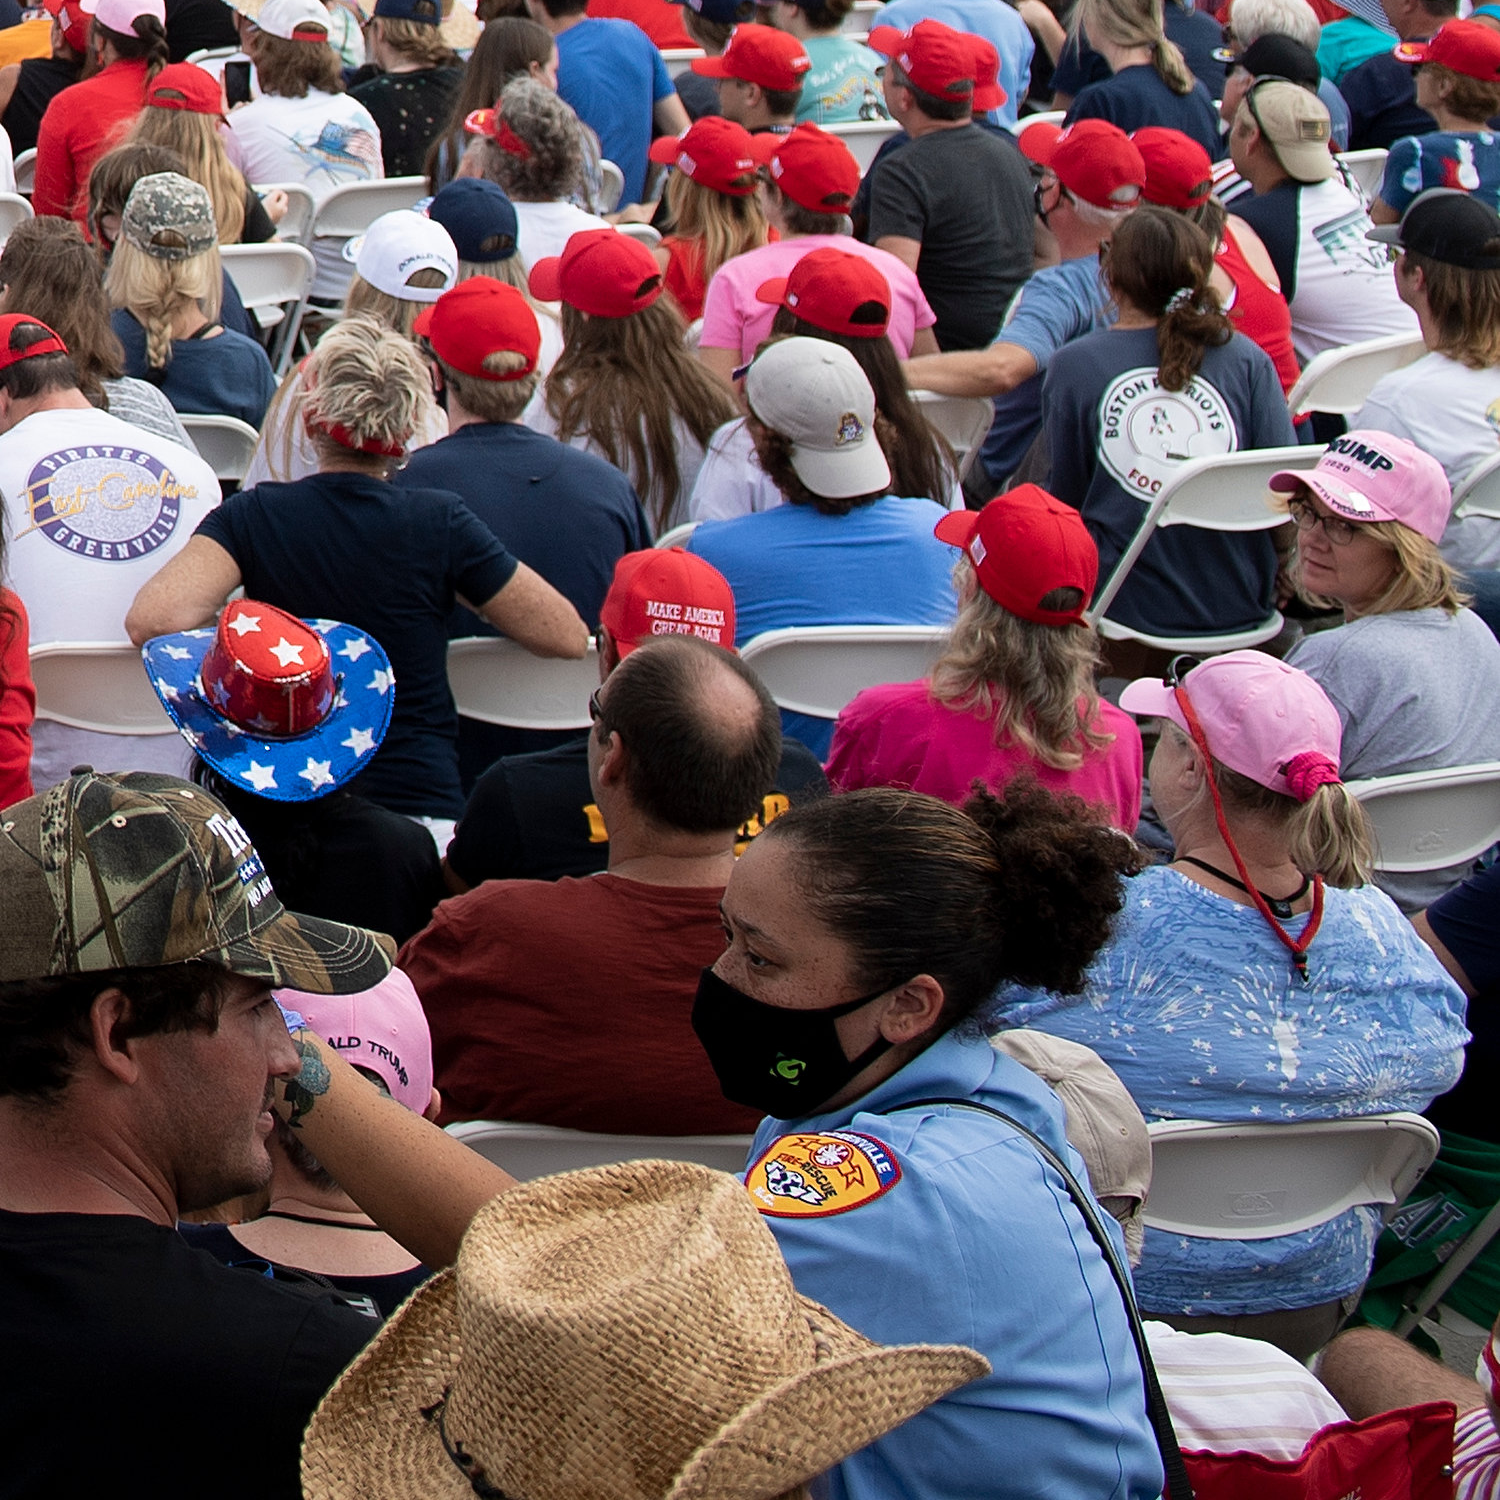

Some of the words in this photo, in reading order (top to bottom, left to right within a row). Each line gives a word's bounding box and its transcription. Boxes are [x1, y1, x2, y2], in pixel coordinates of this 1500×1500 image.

[1105, 380, 1149, 439] BOSTON
[41, 446, 152, 471] PIRATES
[14, 476, 90, 541] East
[99, 469, 199, 511] Carolina
[53, 505, 178, 559] GREENVILLE
[646, 600, 682, 620] MAKE
[684, 607, 726, 627] AMERICA
[651, 619, 690, 636] GREAT
[693, 623, 722, 645] AGAIN
[327, 1036, 362, 1050] ALD
[367, 1040, 409, 1087] TRUMP
